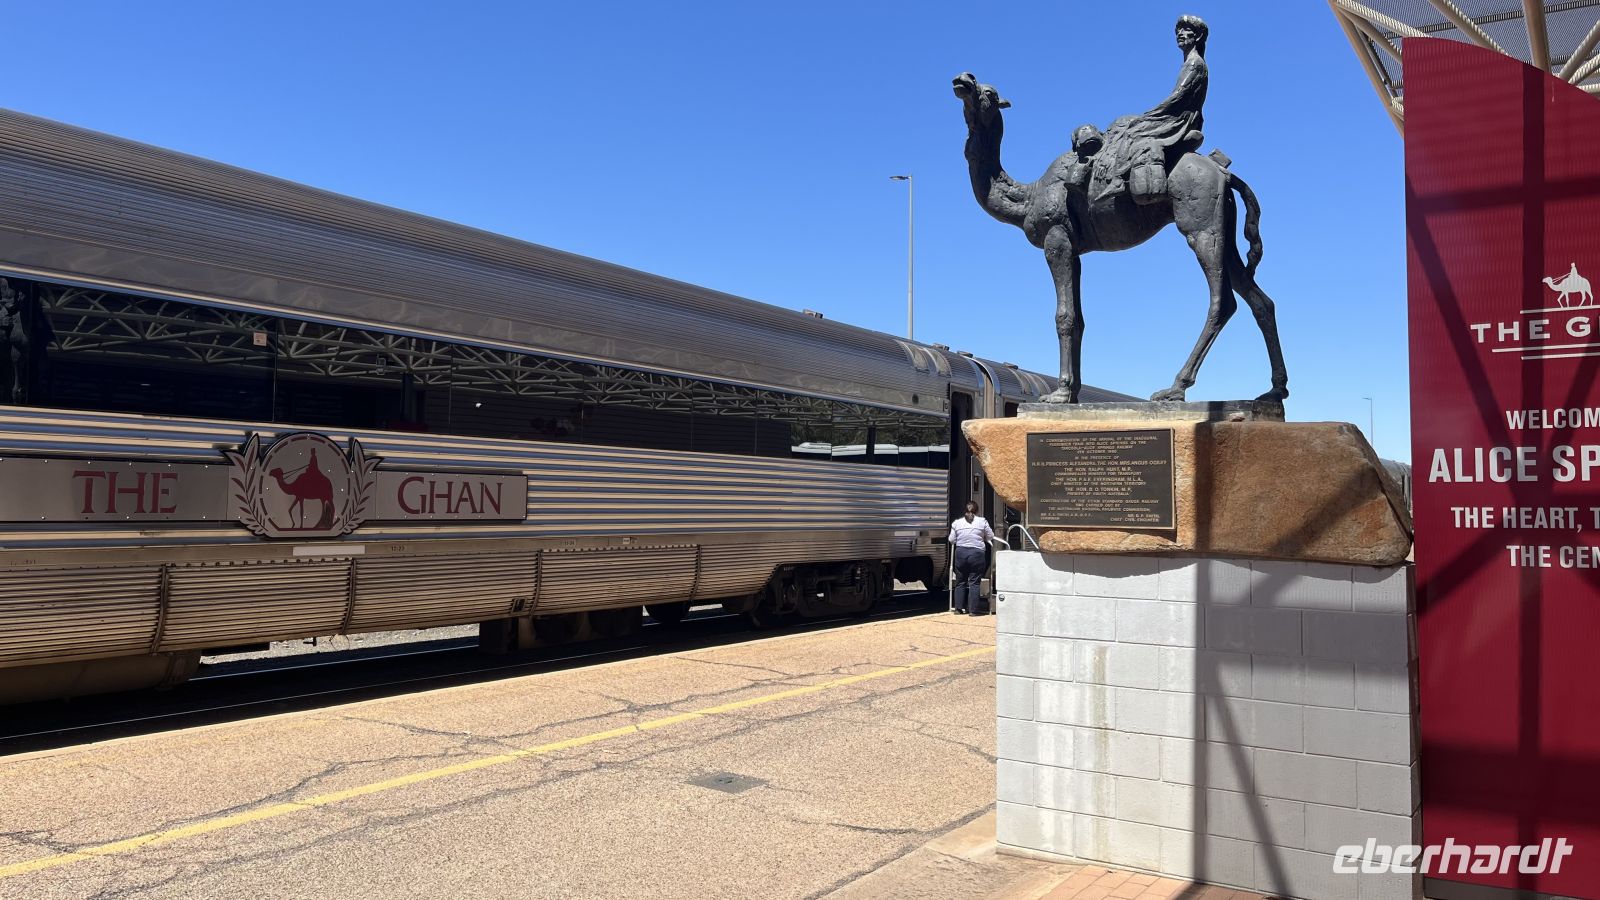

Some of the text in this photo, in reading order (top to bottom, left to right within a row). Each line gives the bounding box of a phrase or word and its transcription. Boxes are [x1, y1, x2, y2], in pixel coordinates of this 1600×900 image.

[1470, 316, 1600, 343] THE G
[1506, 408, 1600, 430] WELCOM
[1428, 445, 1600, 482] ALICE SP
[72, 470, 503, 514] THE GHAN
[1451, 507, 1495, 528] THE
[1502, 507, 1582, 533] HEART,
[1506, 545, 1552, 568] THE
